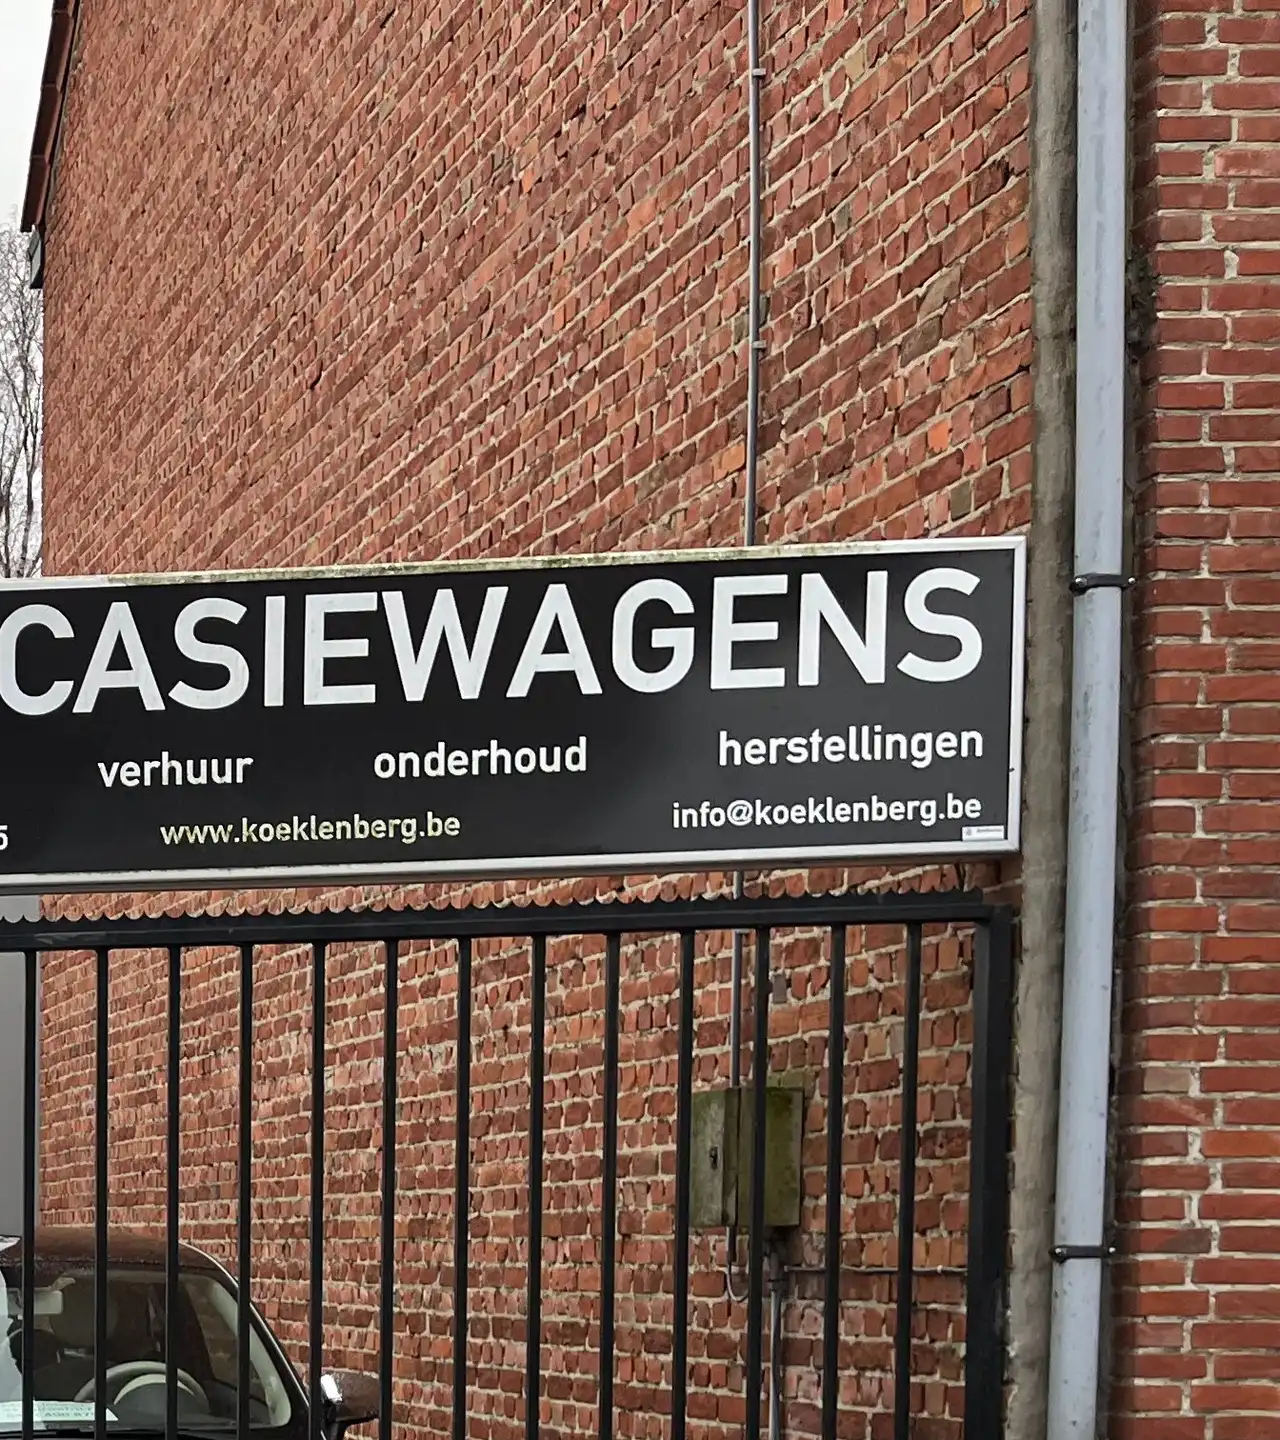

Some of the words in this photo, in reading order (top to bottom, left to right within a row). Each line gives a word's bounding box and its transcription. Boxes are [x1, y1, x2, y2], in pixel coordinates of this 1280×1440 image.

[374, 736, 587, 779] onderhoud
[719, 725, 984, 769] herstellingen
[98, 752, 253, 788] verhuur
[159, 811, 461, 845] www.koeklenberg.be
[672, 793, 983, 829] info@koeklenberg.be
